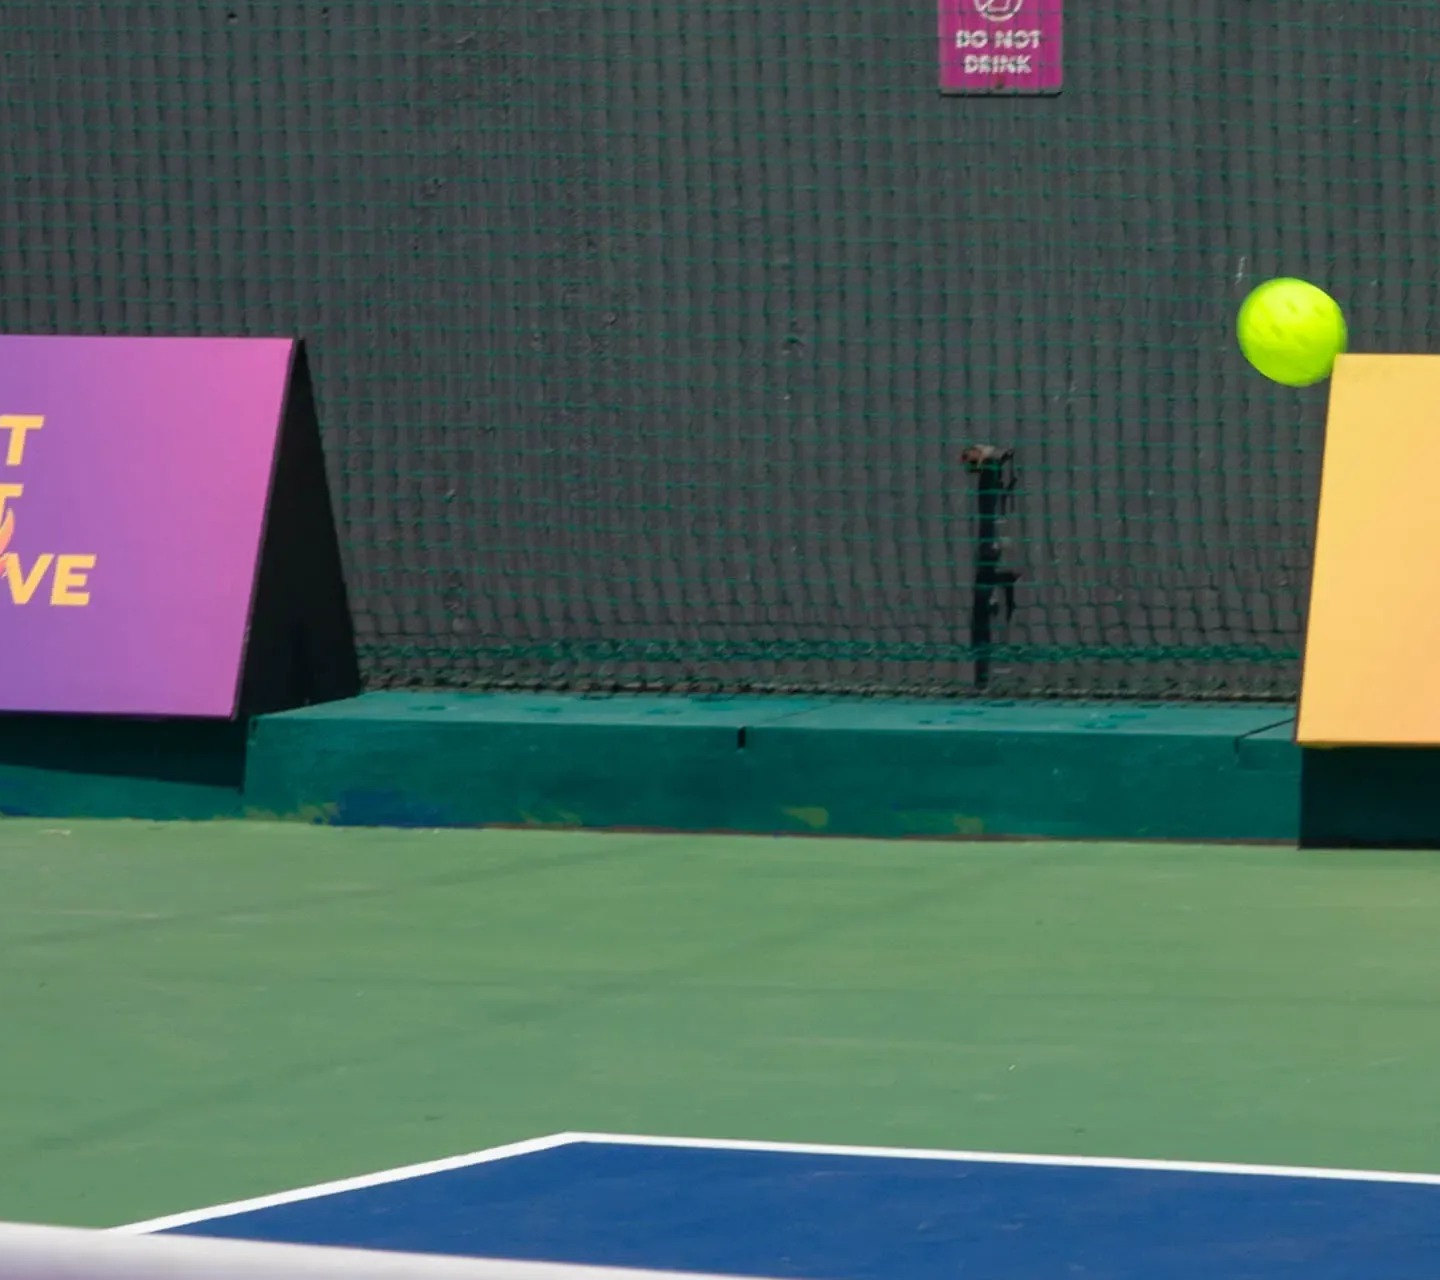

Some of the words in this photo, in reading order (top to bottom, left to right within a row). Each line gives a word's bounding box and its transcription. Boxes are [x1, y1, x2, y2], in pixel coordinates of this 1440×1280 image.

[955, 29, 989, 49] DO
[994, 29, 1042, 49] NOT
[964, 54, 1033, 74] DRINK
